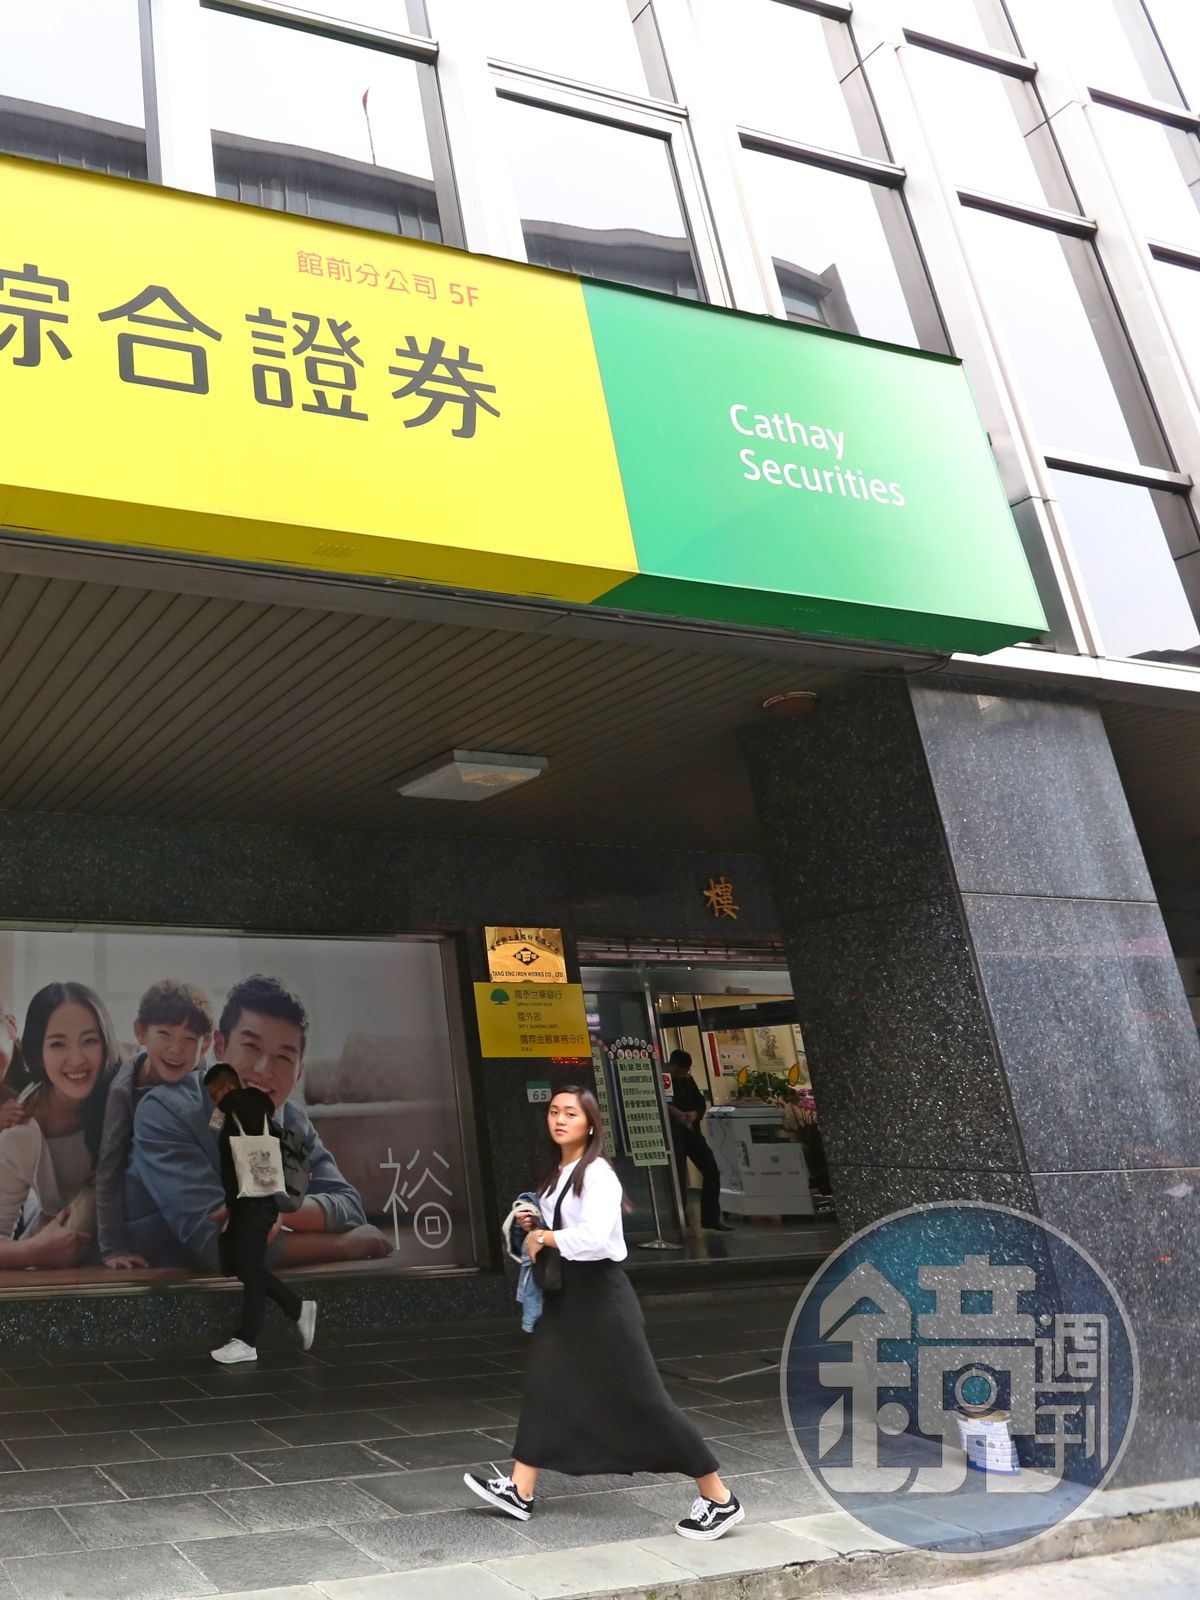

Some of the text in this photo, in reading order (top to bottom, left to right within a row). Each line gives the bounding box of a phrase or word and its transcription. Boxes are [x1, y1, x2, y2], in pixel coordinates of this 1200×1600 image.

[296, 250, 480, 307] 館前分公司 5F
[729, 403, 845, 460] Cathay
[738, 448, 906, 507] Securities
[703, 875, 740, 920] 樓
[532, 1090, 547, 1101] 65
